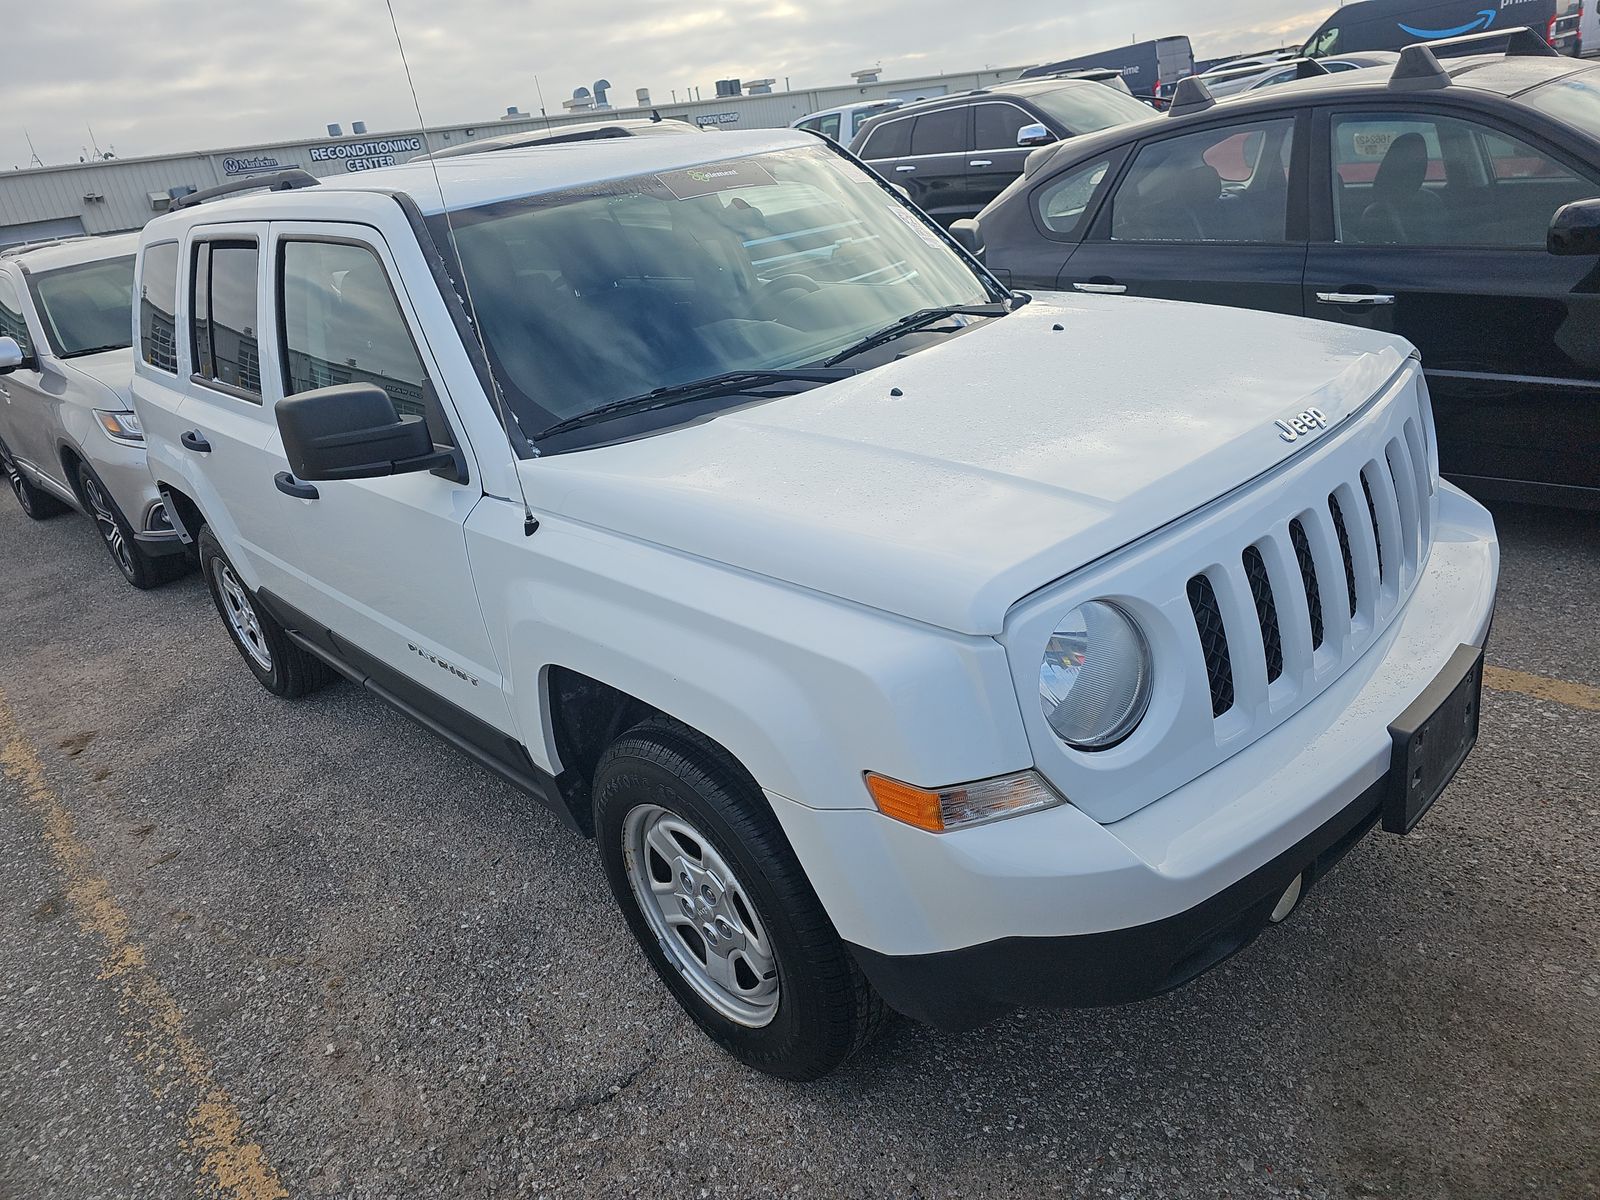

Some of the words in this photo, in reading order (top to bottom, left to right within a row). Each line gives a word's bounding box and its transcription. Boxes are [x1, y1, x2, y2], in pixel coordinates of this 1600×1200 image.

[310, 138, 421, 162] RECONDITIONING
[239, 157, 279, 169] Manheim
[346, 155, 396, 172] CENTER
[704, 169, 739, 178] element
[1274, 407, 1327, 443] Jeep
[407, 641, 479, 687] PATRIOT
